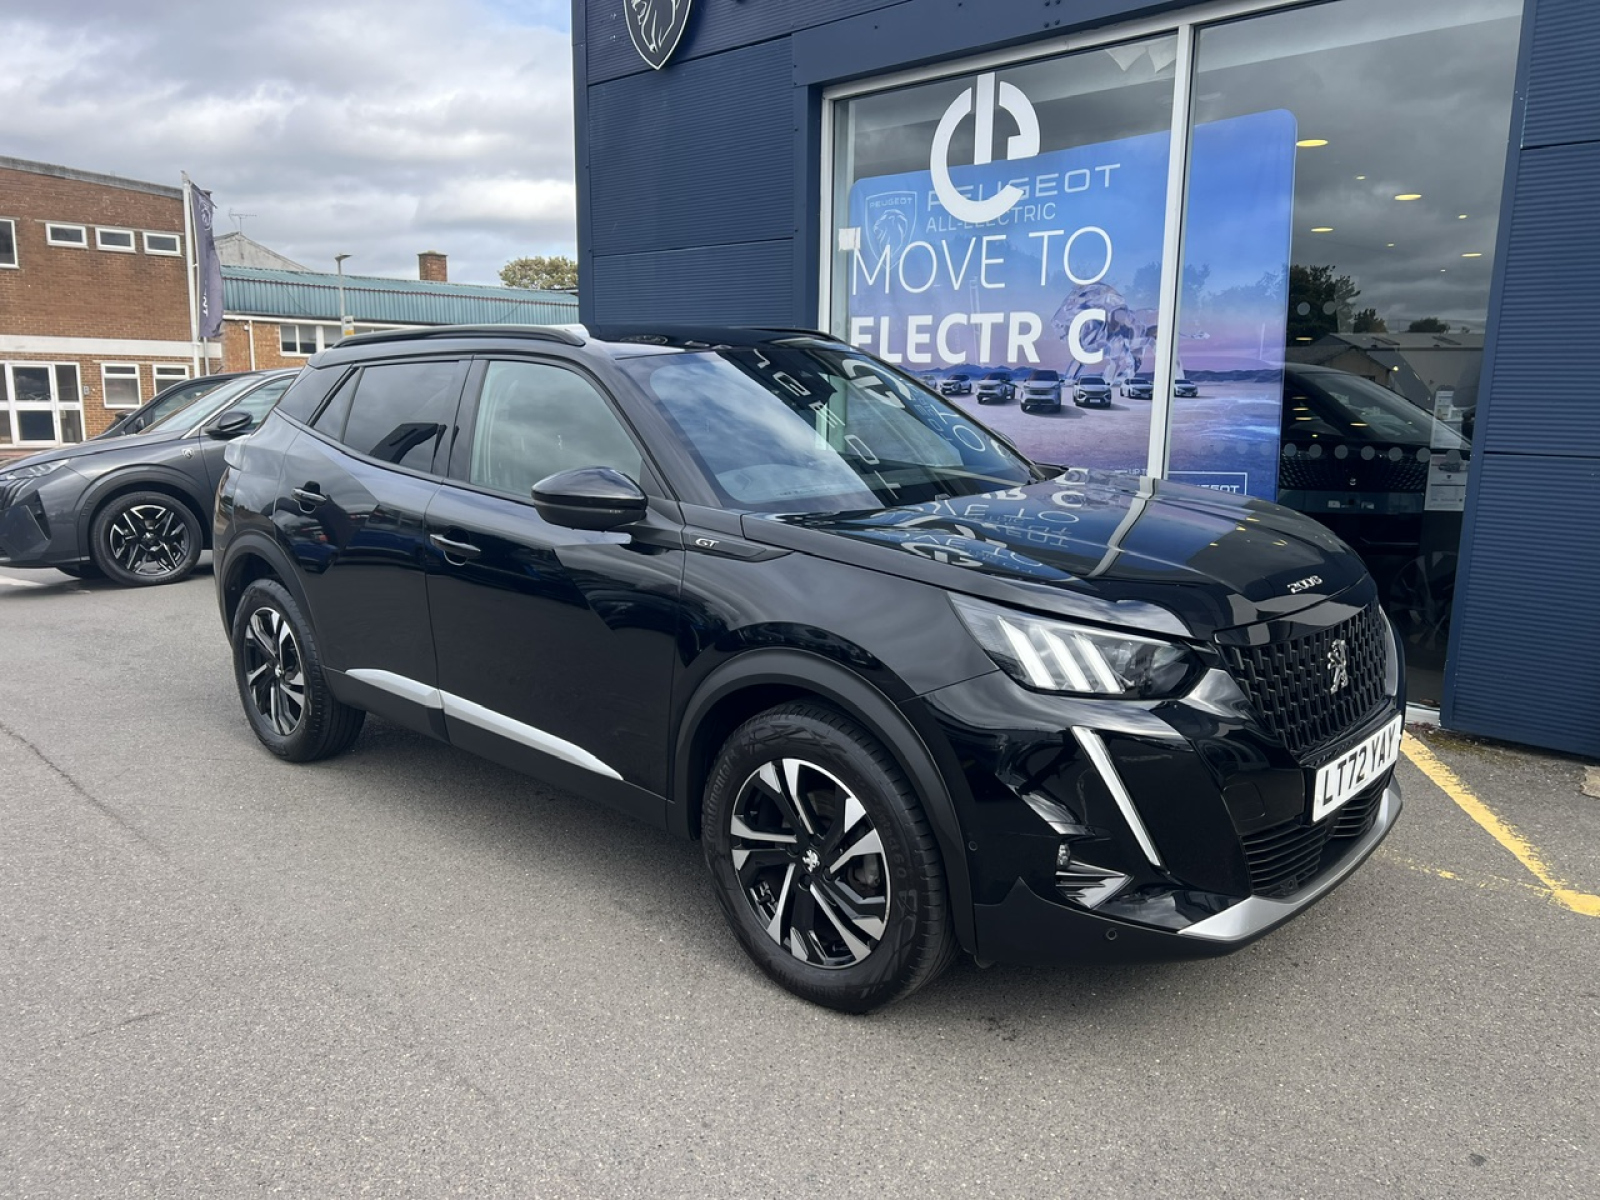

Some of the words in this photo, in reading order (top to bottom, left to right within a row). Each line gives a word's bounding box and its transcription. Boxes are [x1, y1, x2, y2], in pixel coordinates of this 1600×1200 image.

[870, 197, 913, 209] PEUGEOT
[852, 234, 1006, 296] MOVE
[1029, 226, 1113, 286] TO
[695, 538, 720, 548] GT
[1322, 745, 1368, 806] LT72
[1371, 723, 1396, 773] YAY
